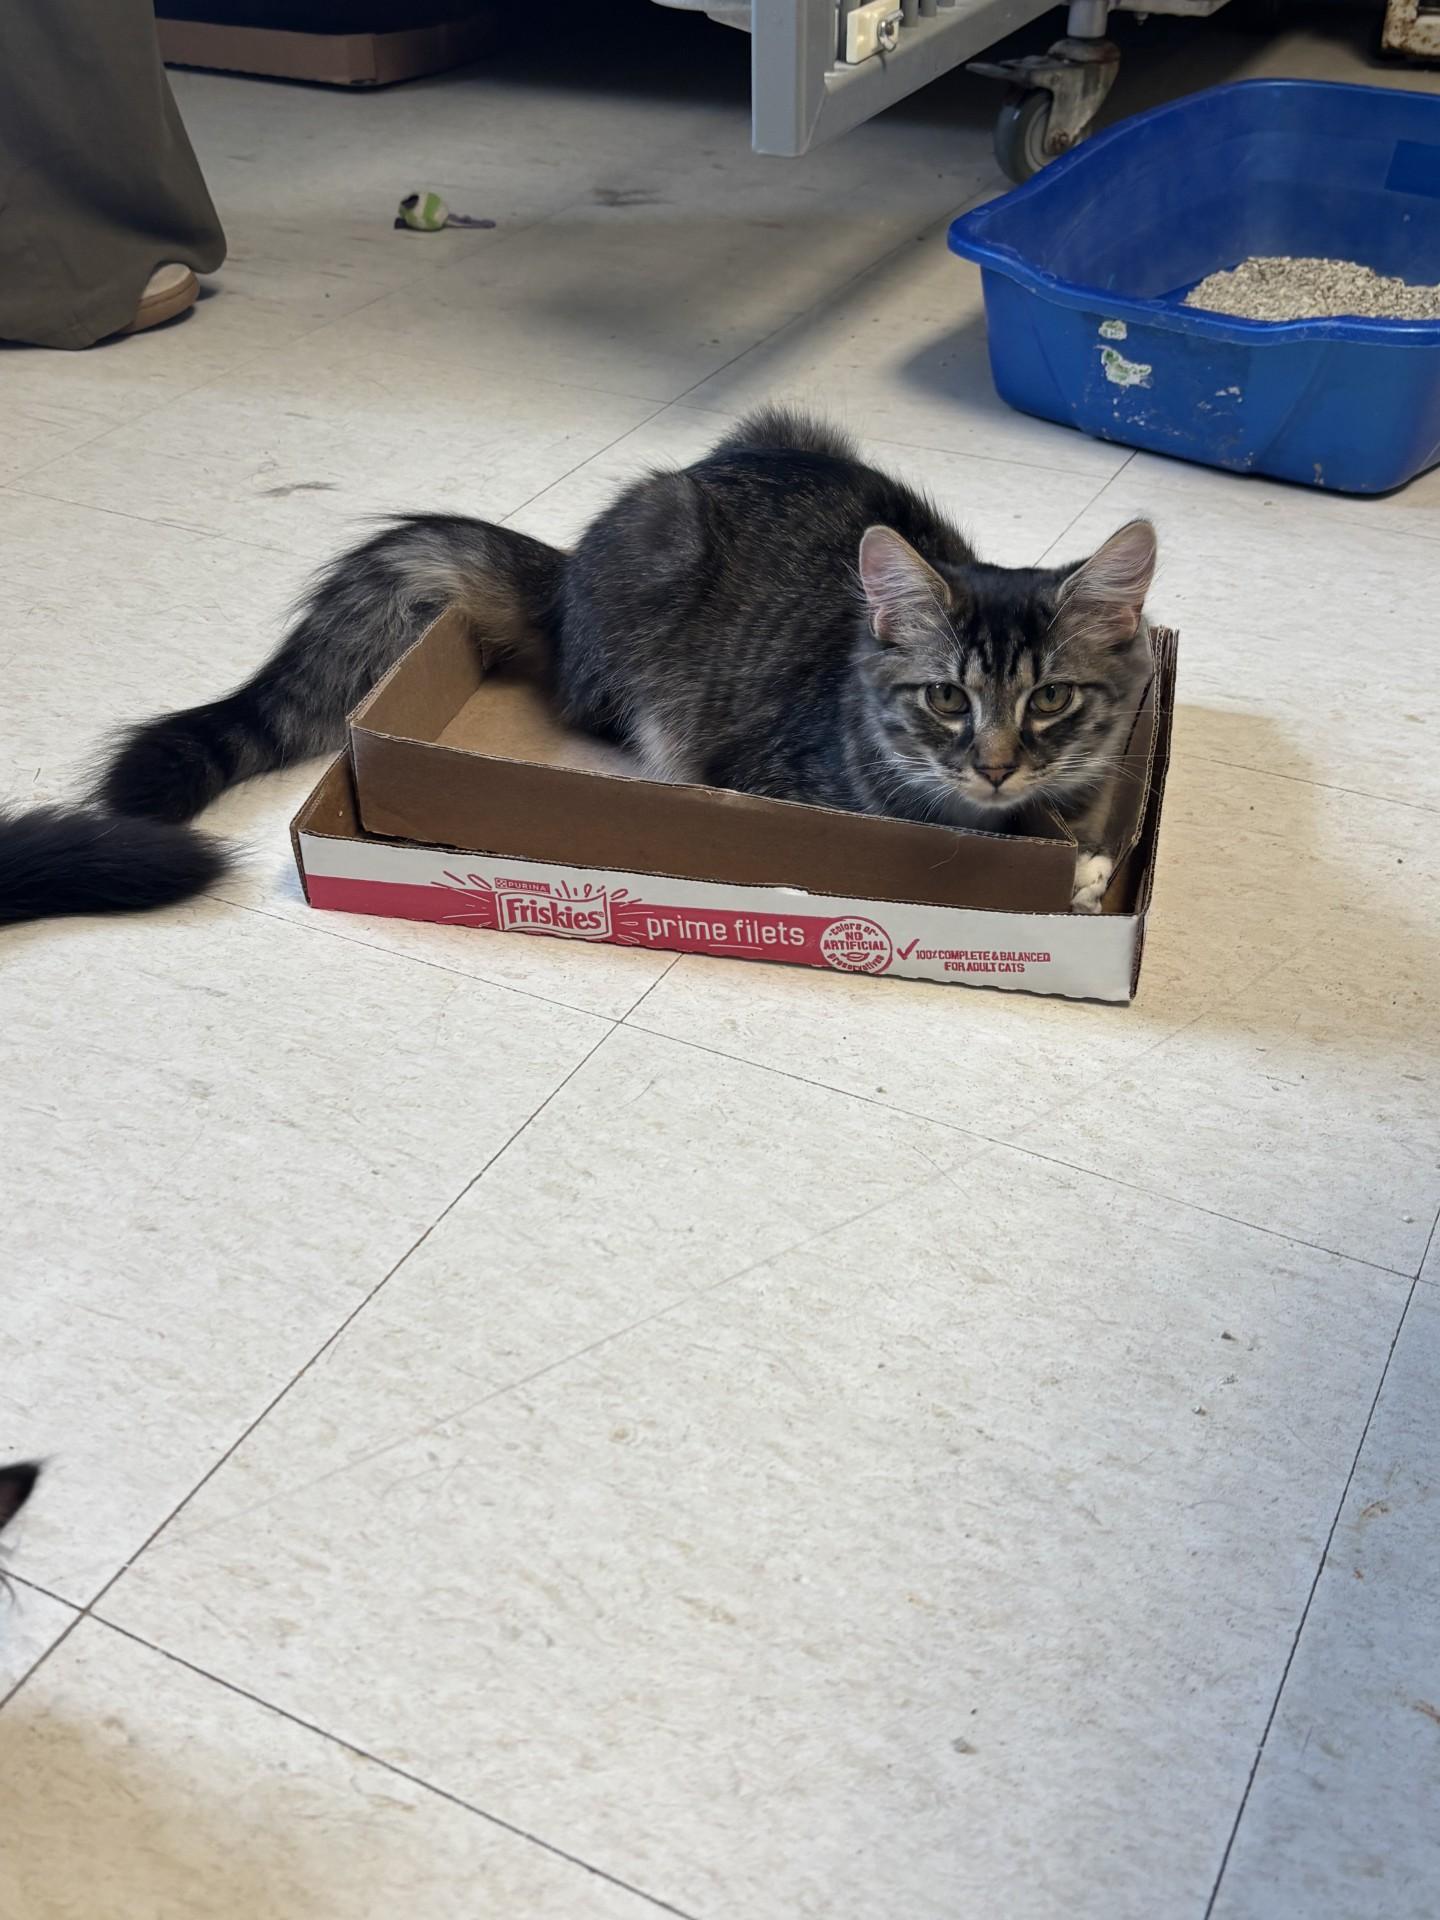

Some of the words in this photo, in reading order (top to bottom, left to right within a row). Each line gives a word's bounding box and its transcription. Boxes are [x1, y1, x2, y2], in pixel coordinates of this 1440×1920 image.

[507, 880, 548, 892] PURINA
[506, 897, 602, 931] Friskies
[646, 914, 728, 941] prime
[733, 919, 805, 946] filets
[845, 931, 864, 941] NO
[823, 940, 888, 951] ARTIFICIAL
[916, 950, 937, 960] 100%
[938, 950, 991, 961] COMPLETE
[999, 951, 1051, 963] BALANCED
[944, 961, 966, 972] FOR
[966, 962, 996, 973] ADULT
[998, 962, 1025, 973] CATS
